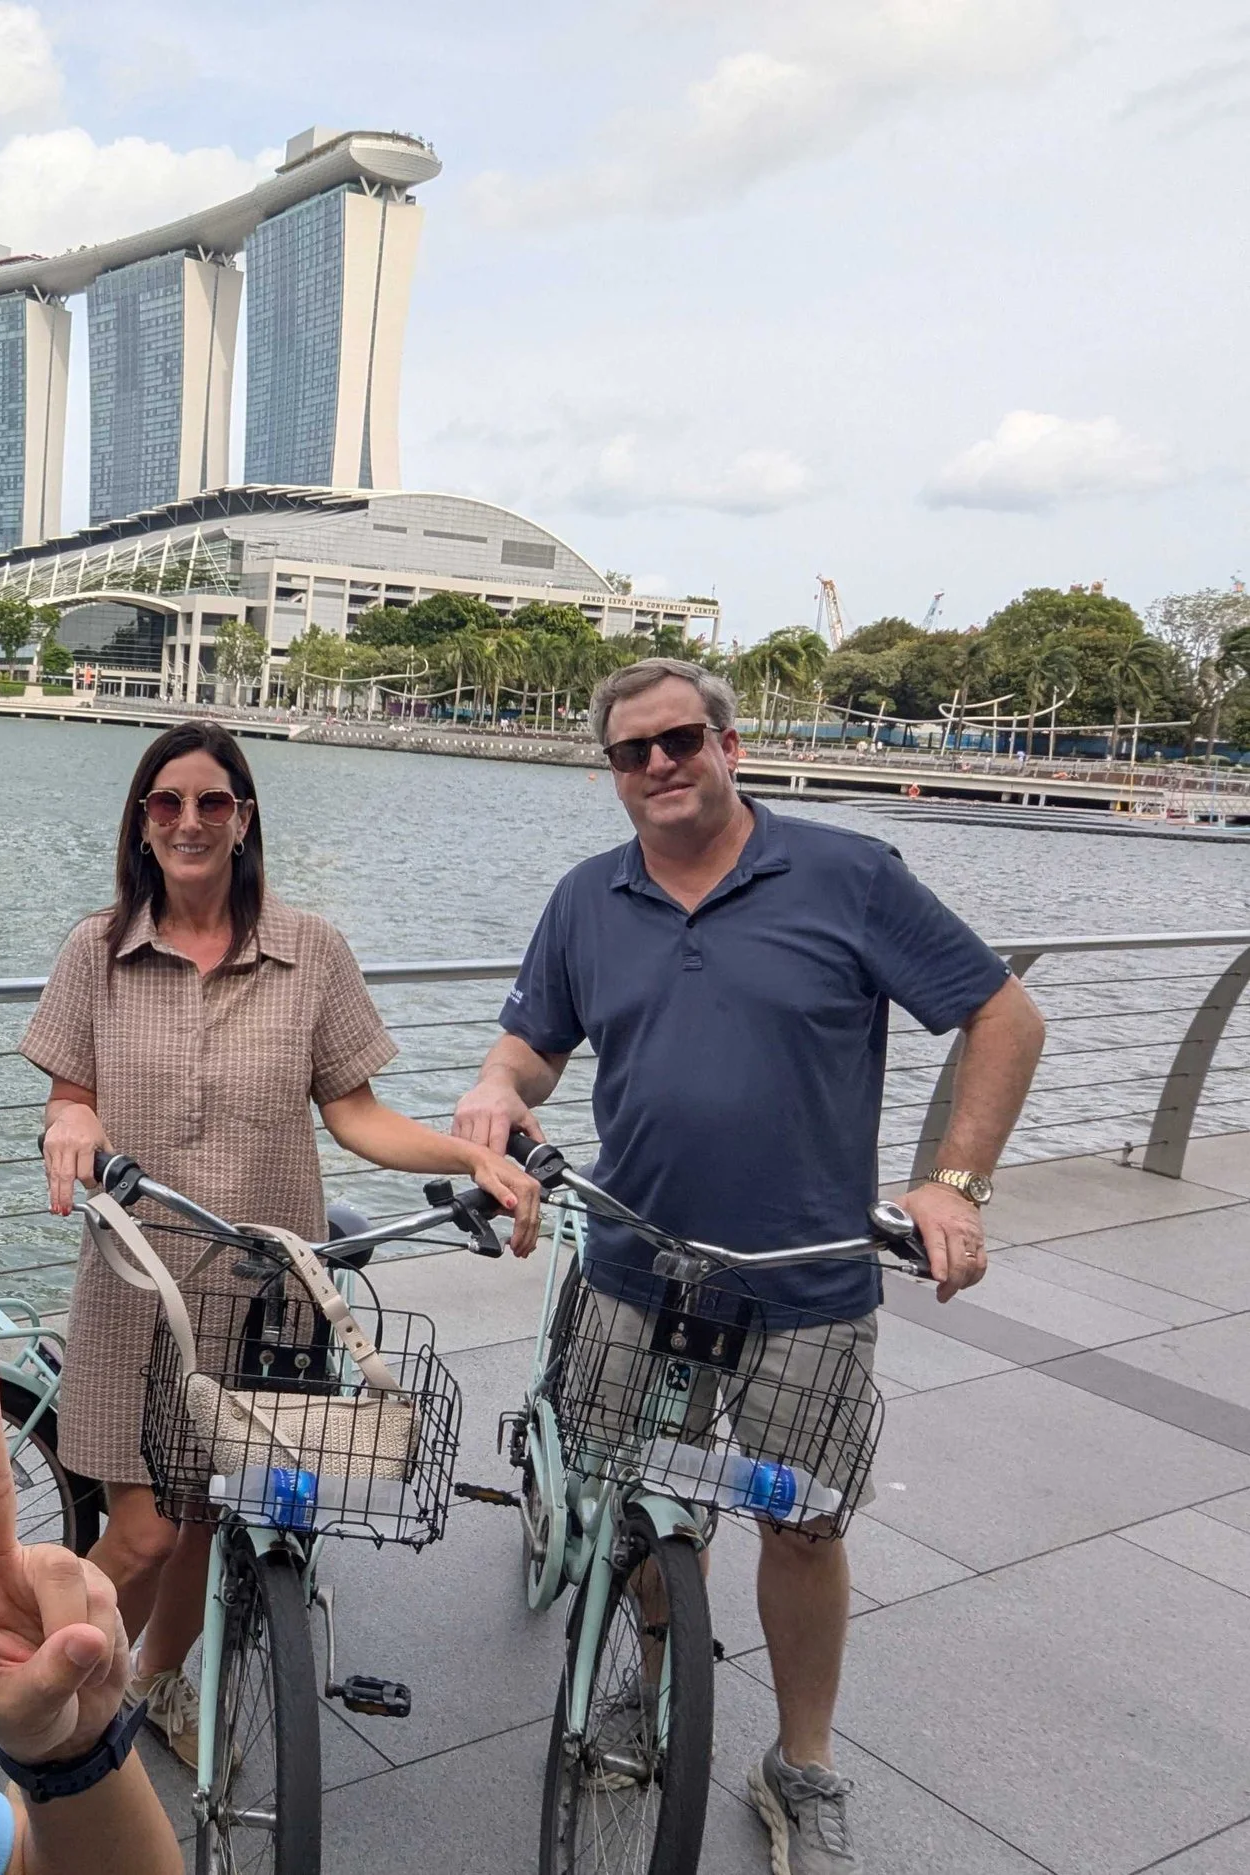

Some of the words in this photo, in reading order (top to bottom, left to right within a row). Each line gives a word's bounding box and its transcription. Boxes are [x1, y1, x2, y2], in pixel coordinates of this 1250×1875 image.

[582, 594, 605, 603] SANDS
[608, 598, 627, 606] EXPO
[646, 602, 691, 612] CONVENTION
[693, 606, 719, 615] CENTRE
